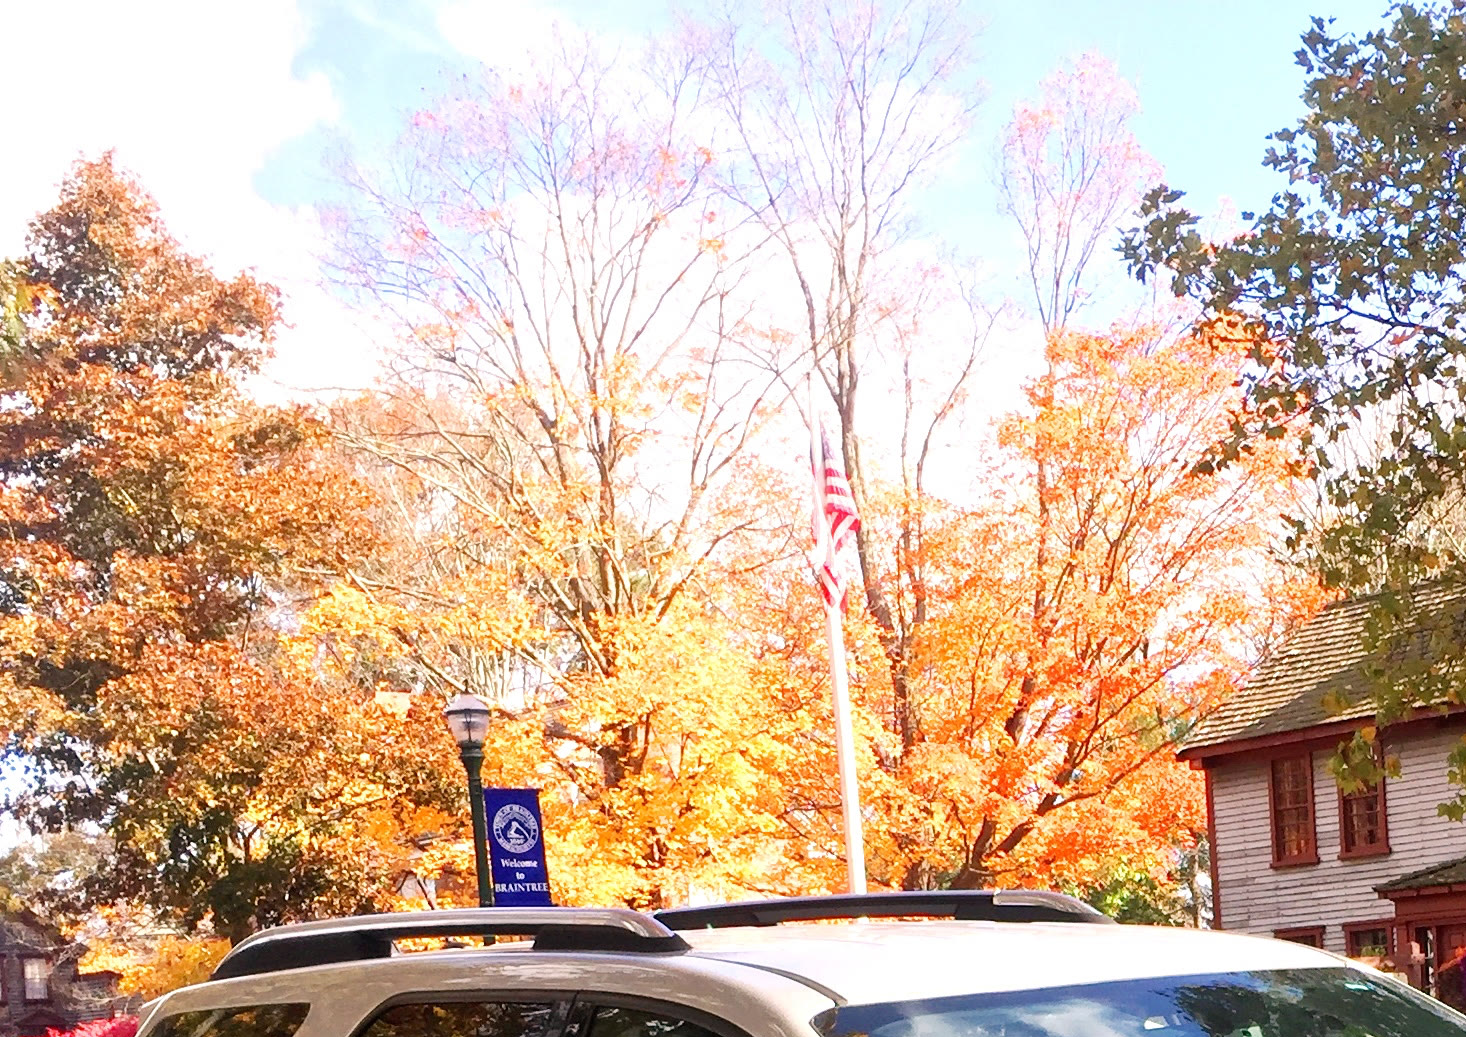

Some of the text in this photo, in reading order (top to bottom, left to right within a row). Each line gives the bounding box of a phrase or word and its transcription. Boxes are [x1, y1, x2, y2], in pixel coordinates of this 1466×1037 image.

[500, 858, 538, 868] Welcome
[515, 871, 525, 880] to
[494, 882, 549, 892] BRAINTREE
